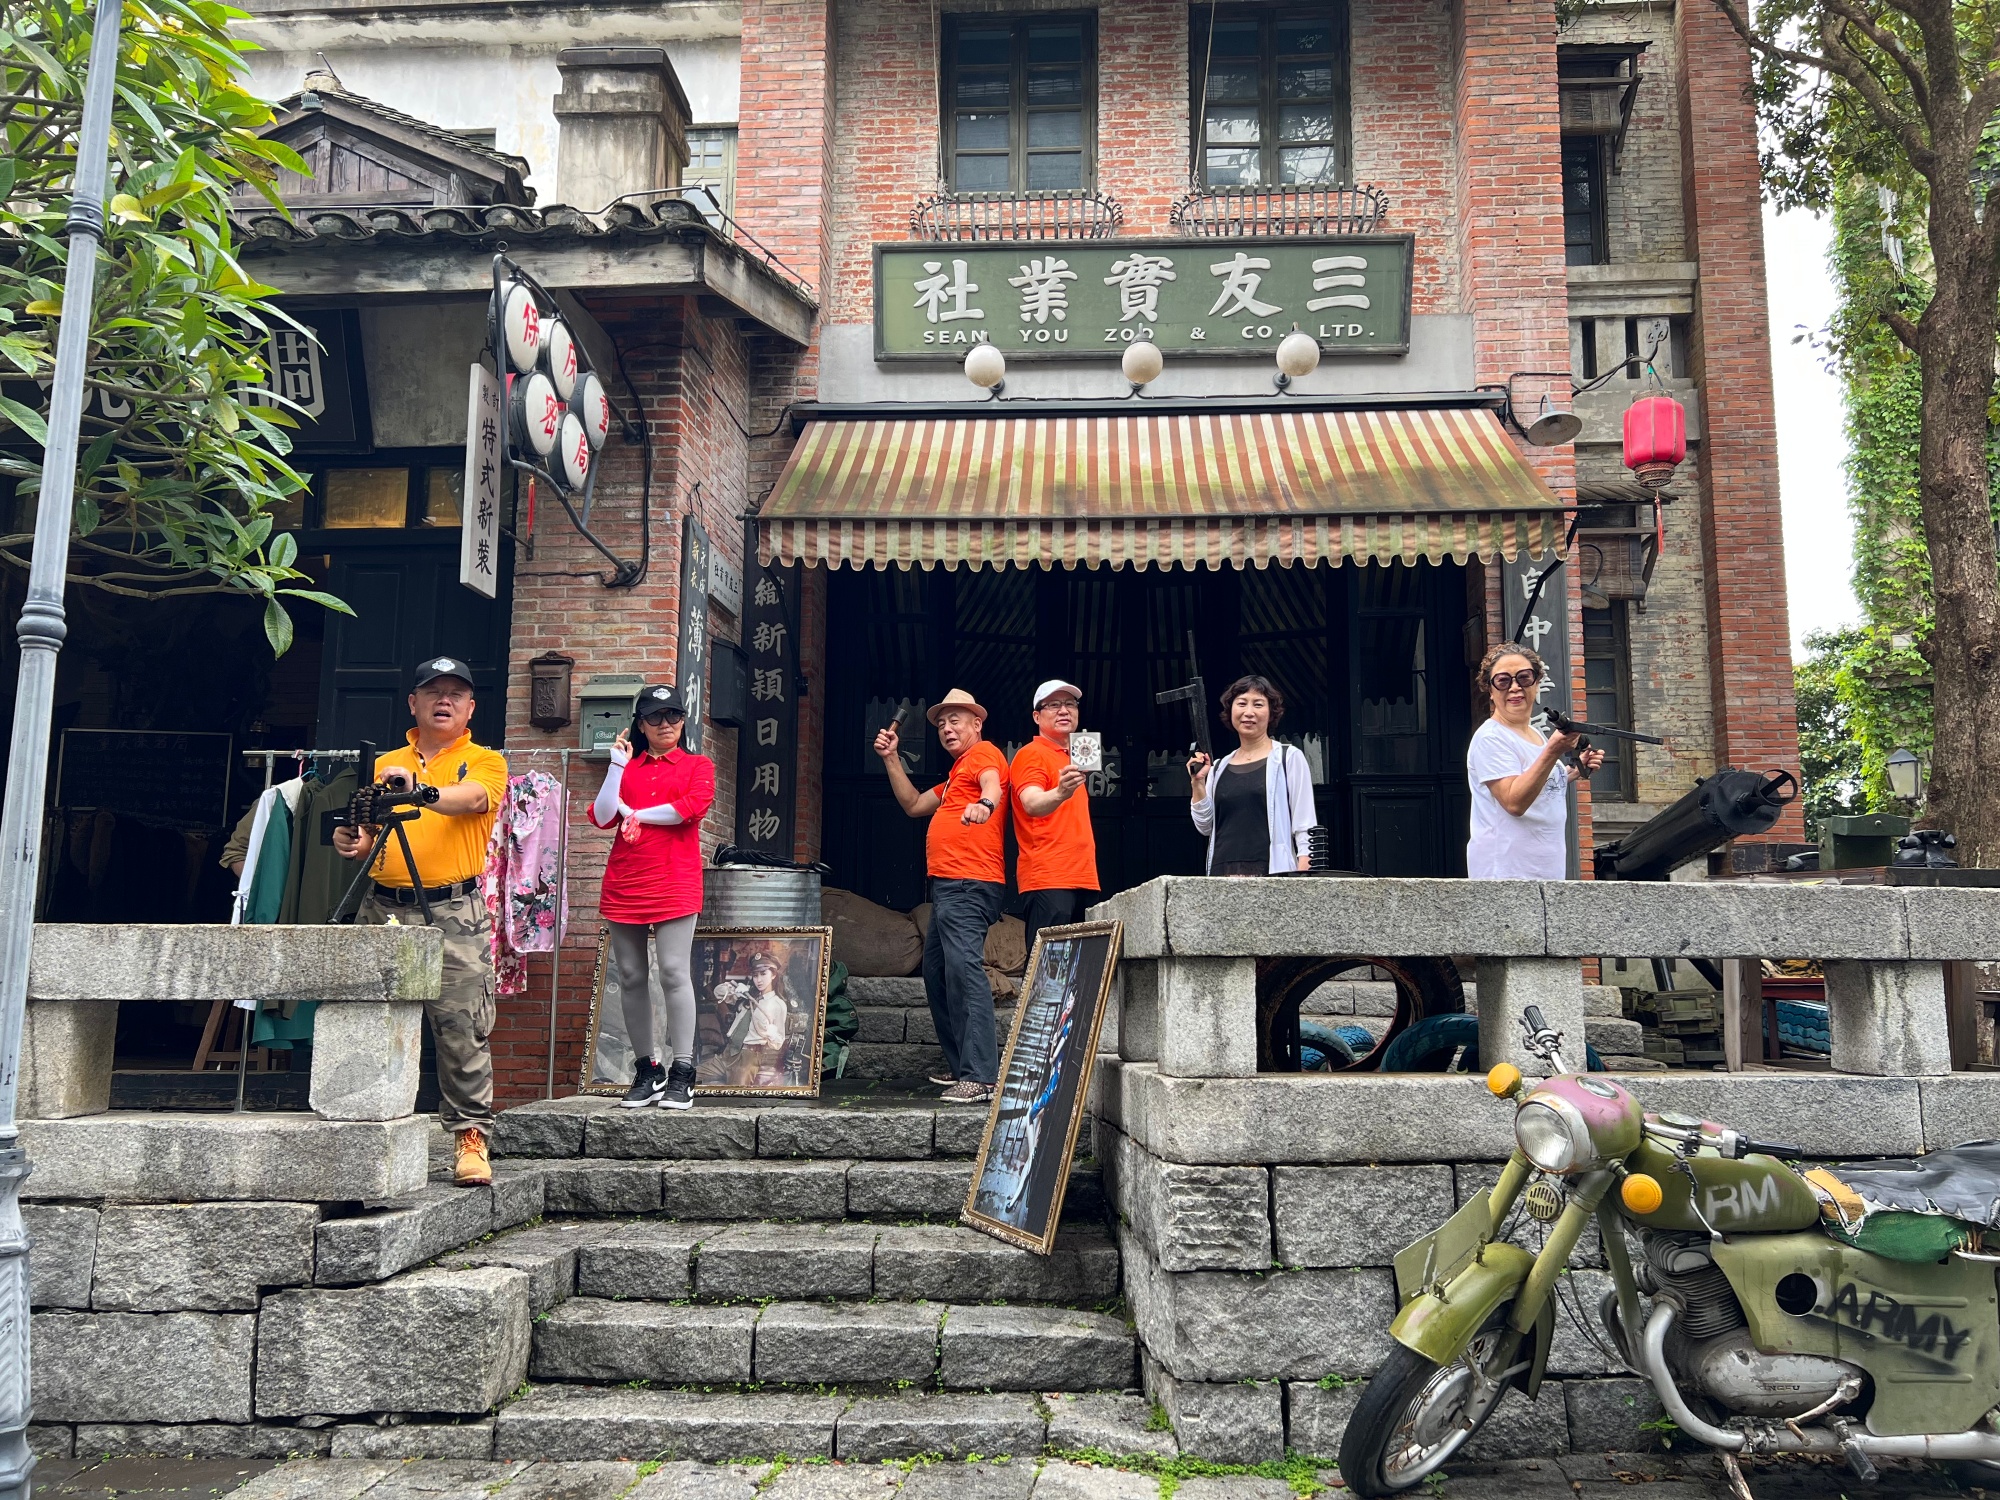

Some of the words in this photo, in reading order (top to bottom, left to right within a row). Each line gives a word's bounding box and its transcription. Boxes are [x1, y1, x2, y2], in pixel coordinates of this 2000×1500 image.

[523, 301, 539, 347] 保
[923, 329, 985, 345] SEAN
[1018, 328, 1070, 343] YOU
[1190, 326, 1207, 341] &
[1241, 324, 1285, 340] CO.
[1319, 323, 1376, 338] LTD.
[539, 393, 559, 439] 密
[572, 433, 589, 475] 局
[748, 541, 787, 842] 織新穎日用物
[1824, 1281, 1971, 1361] ARMY
